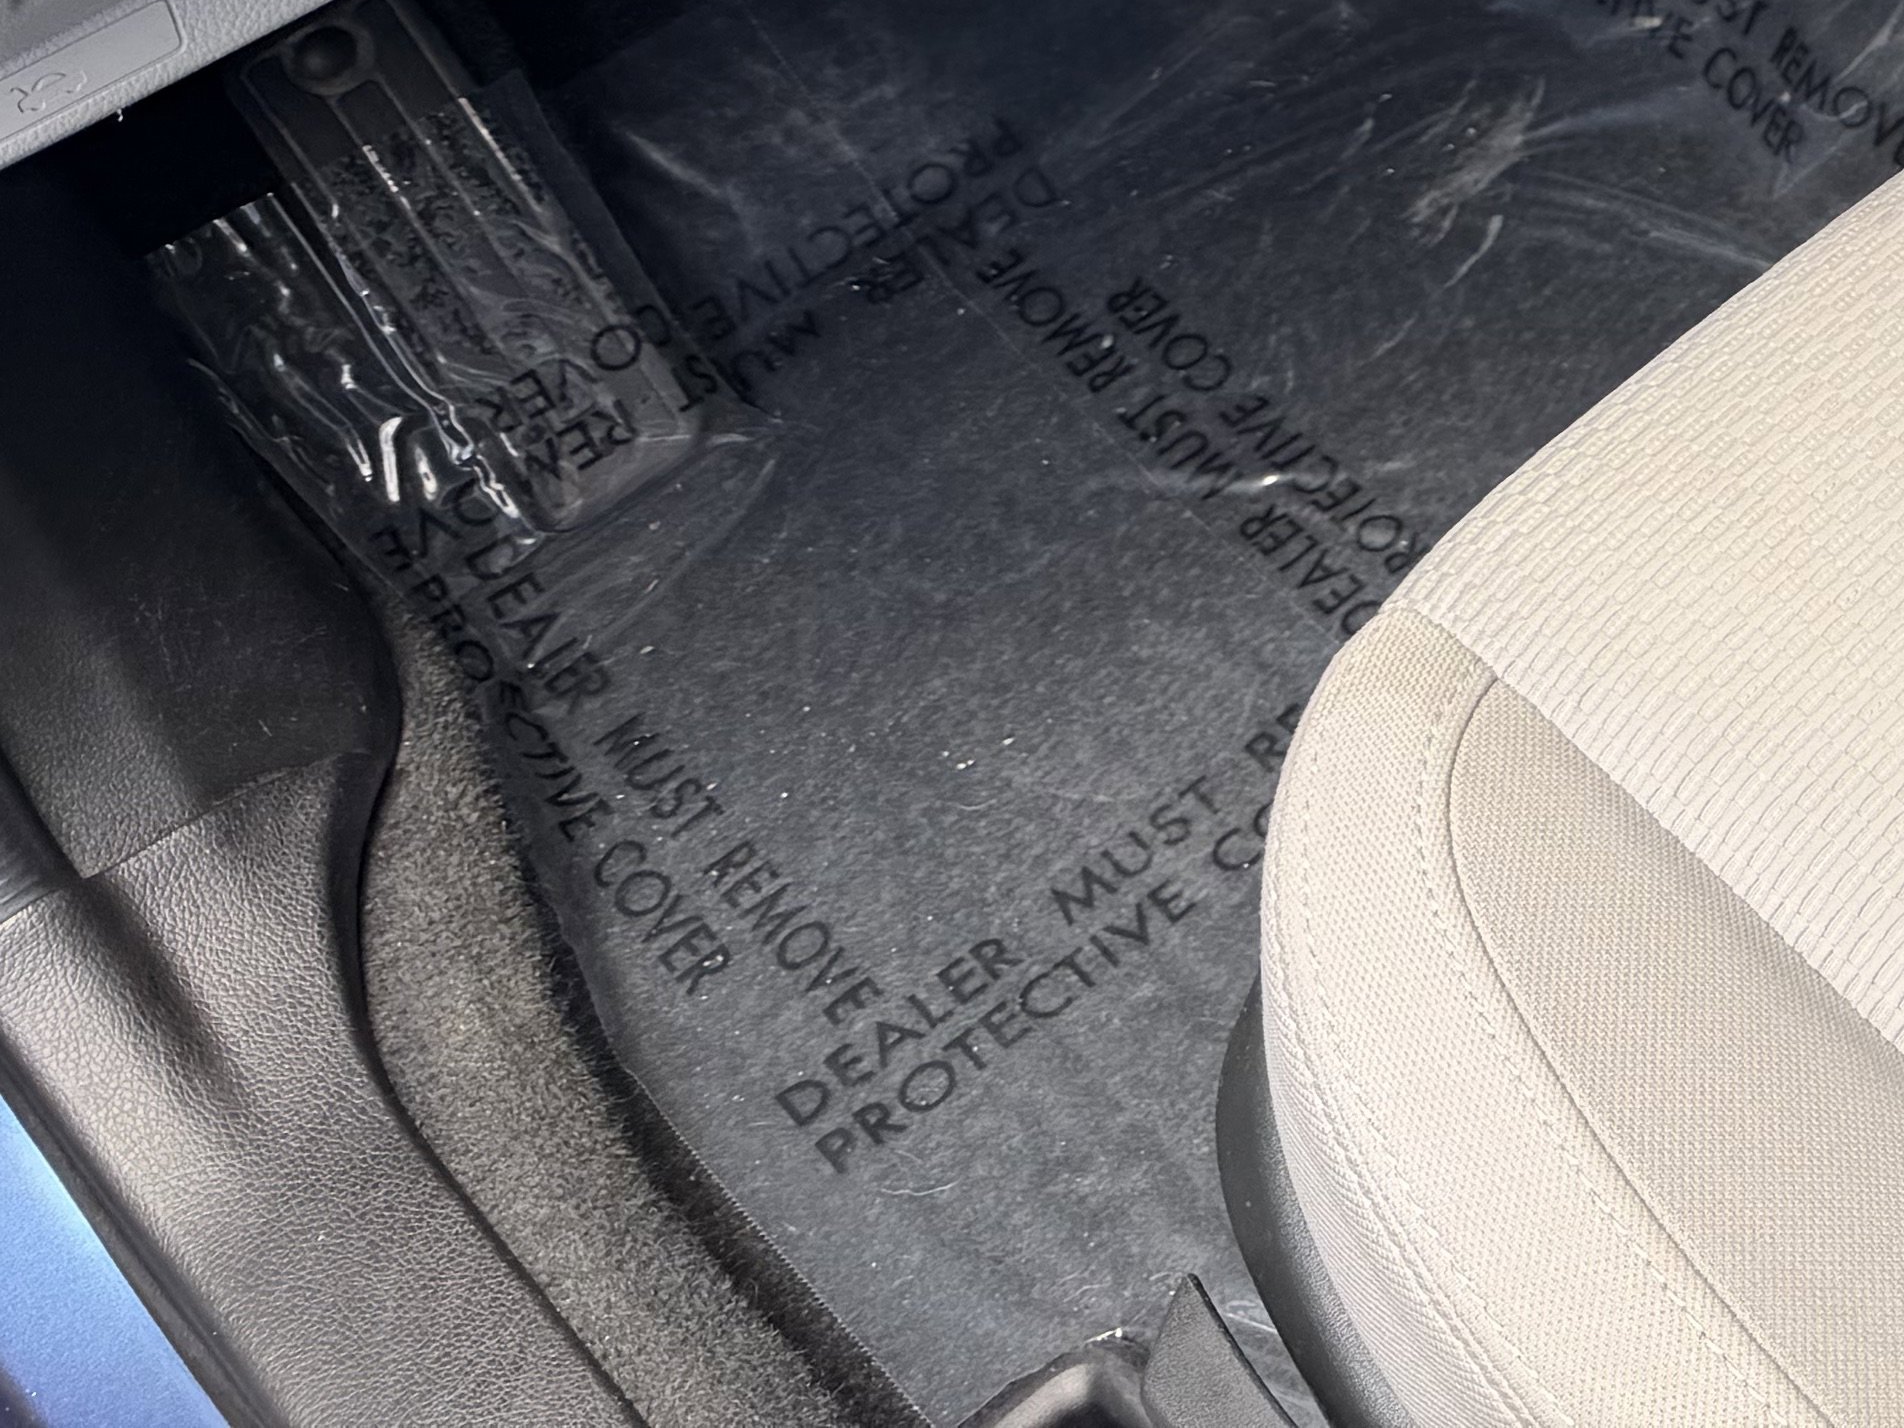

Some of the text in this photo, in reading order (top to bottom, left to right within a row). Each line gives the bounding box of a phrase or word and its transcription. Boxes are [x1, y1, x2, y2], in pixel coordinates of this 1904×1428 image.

[1703, 45, 1807, 164] COVER
[976, 248, 1135, 394] REMOVE
[1105, 276, 1422, 574] ROTECTIVE COVER
[1116, 394, 1243, 501] MUST
[593, 712, 725, 839] MUST
[703, 841, 885, 1027] REMOVE
[593, 839, 731, 995] COVER
[773, 936, 1026, 1128] DEALER
[1051, 775, 1219, 926] MUST
[814, 876, 1198, 1175] PROTECTIVE
